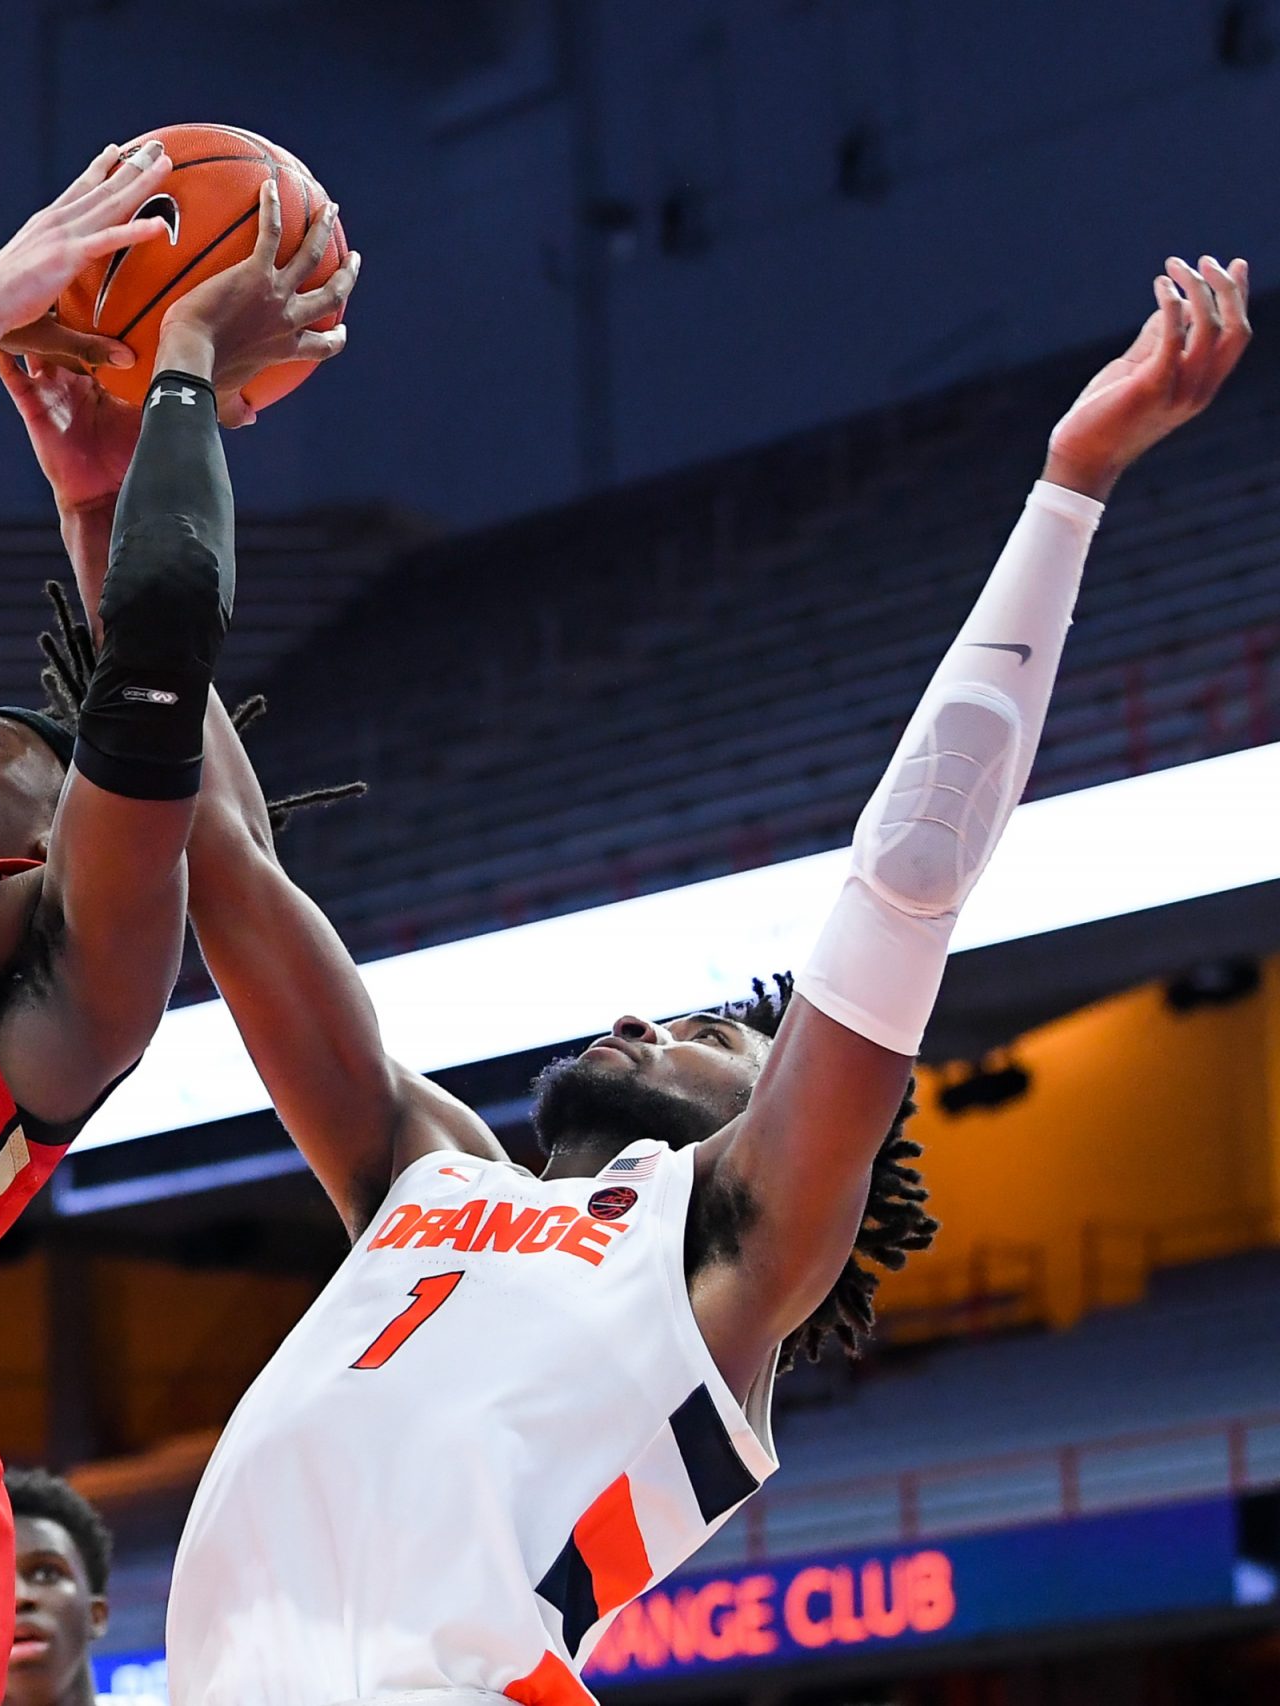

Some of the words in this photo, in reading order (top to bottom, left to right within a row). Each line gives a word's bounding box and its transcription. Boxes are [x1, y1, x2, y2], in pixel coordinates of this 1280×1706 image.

[367, 1199, 629, 1267] ORANGE
[349, 1270, 465, 1369] 1
[583, 1574, 778, 1676] ANGE
[784, 1550, 956, 1648] CLUB
